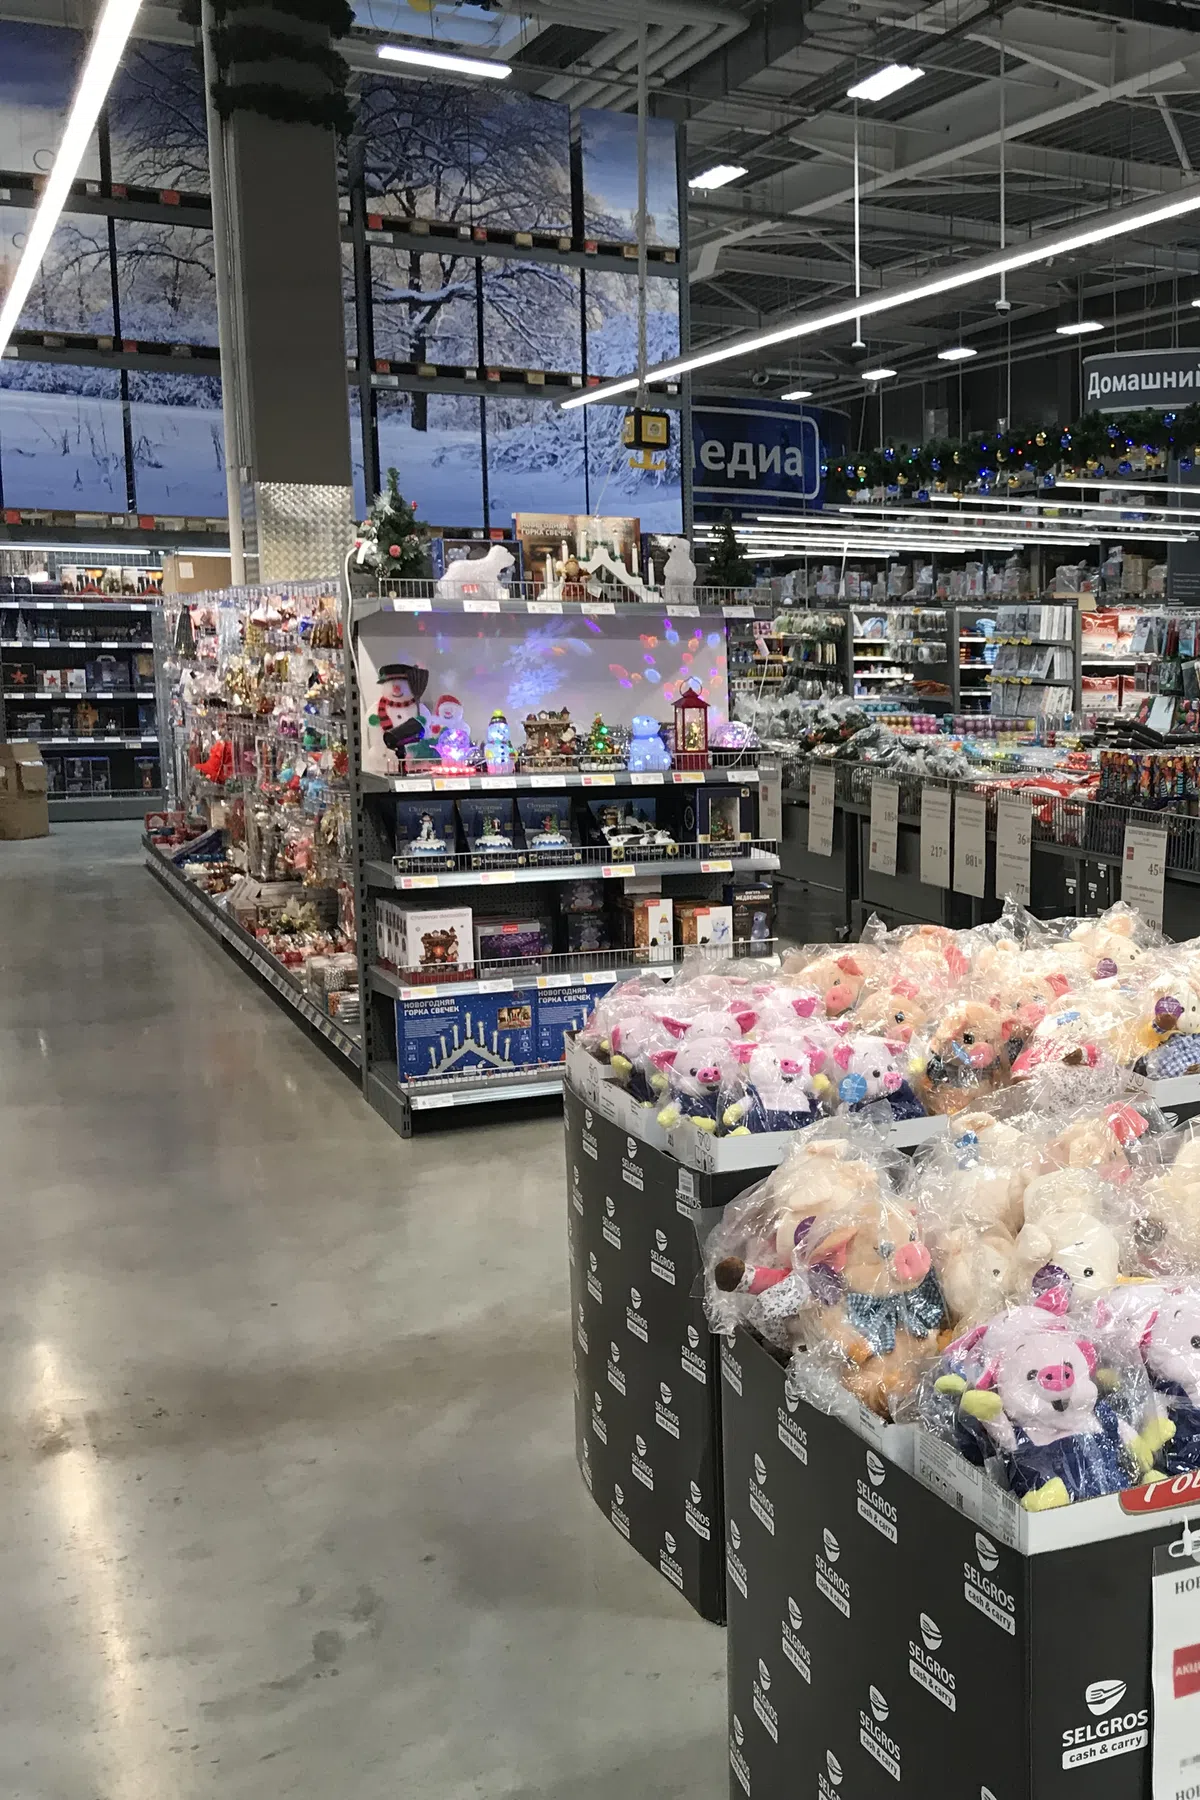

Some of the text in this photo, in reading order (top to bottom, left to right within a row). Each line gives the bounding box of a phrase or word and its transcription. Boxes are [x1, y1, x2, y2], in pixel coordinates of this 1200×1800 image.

[691, 440, 802, 479] едиа
[404, 999, 455, 1009] НОВОГОДНЯЯ
[538, 987, 587, 997] НОВОГОДНЯЯ
[538, 993, 591, 1003] ГОРКА СВЕЧЕК
[404, 1006, 459, 1016] ГОРКА СВЕЧЕК
[650, 1249, 675, 1272] SELGROS
[778, 1407, 807, 1445] SELGROS
[963, 1562, 1015, 1612] SELGROS
[968, 1590, 984, 1608] cash
[992, 1607, 1012, 1630] carry
[909, 1640, 955, 1690] SELGROS
[1062, 1710, 1148, 1747] SELGROS
[1069, 1735, 1142, 1763] cash & carry
